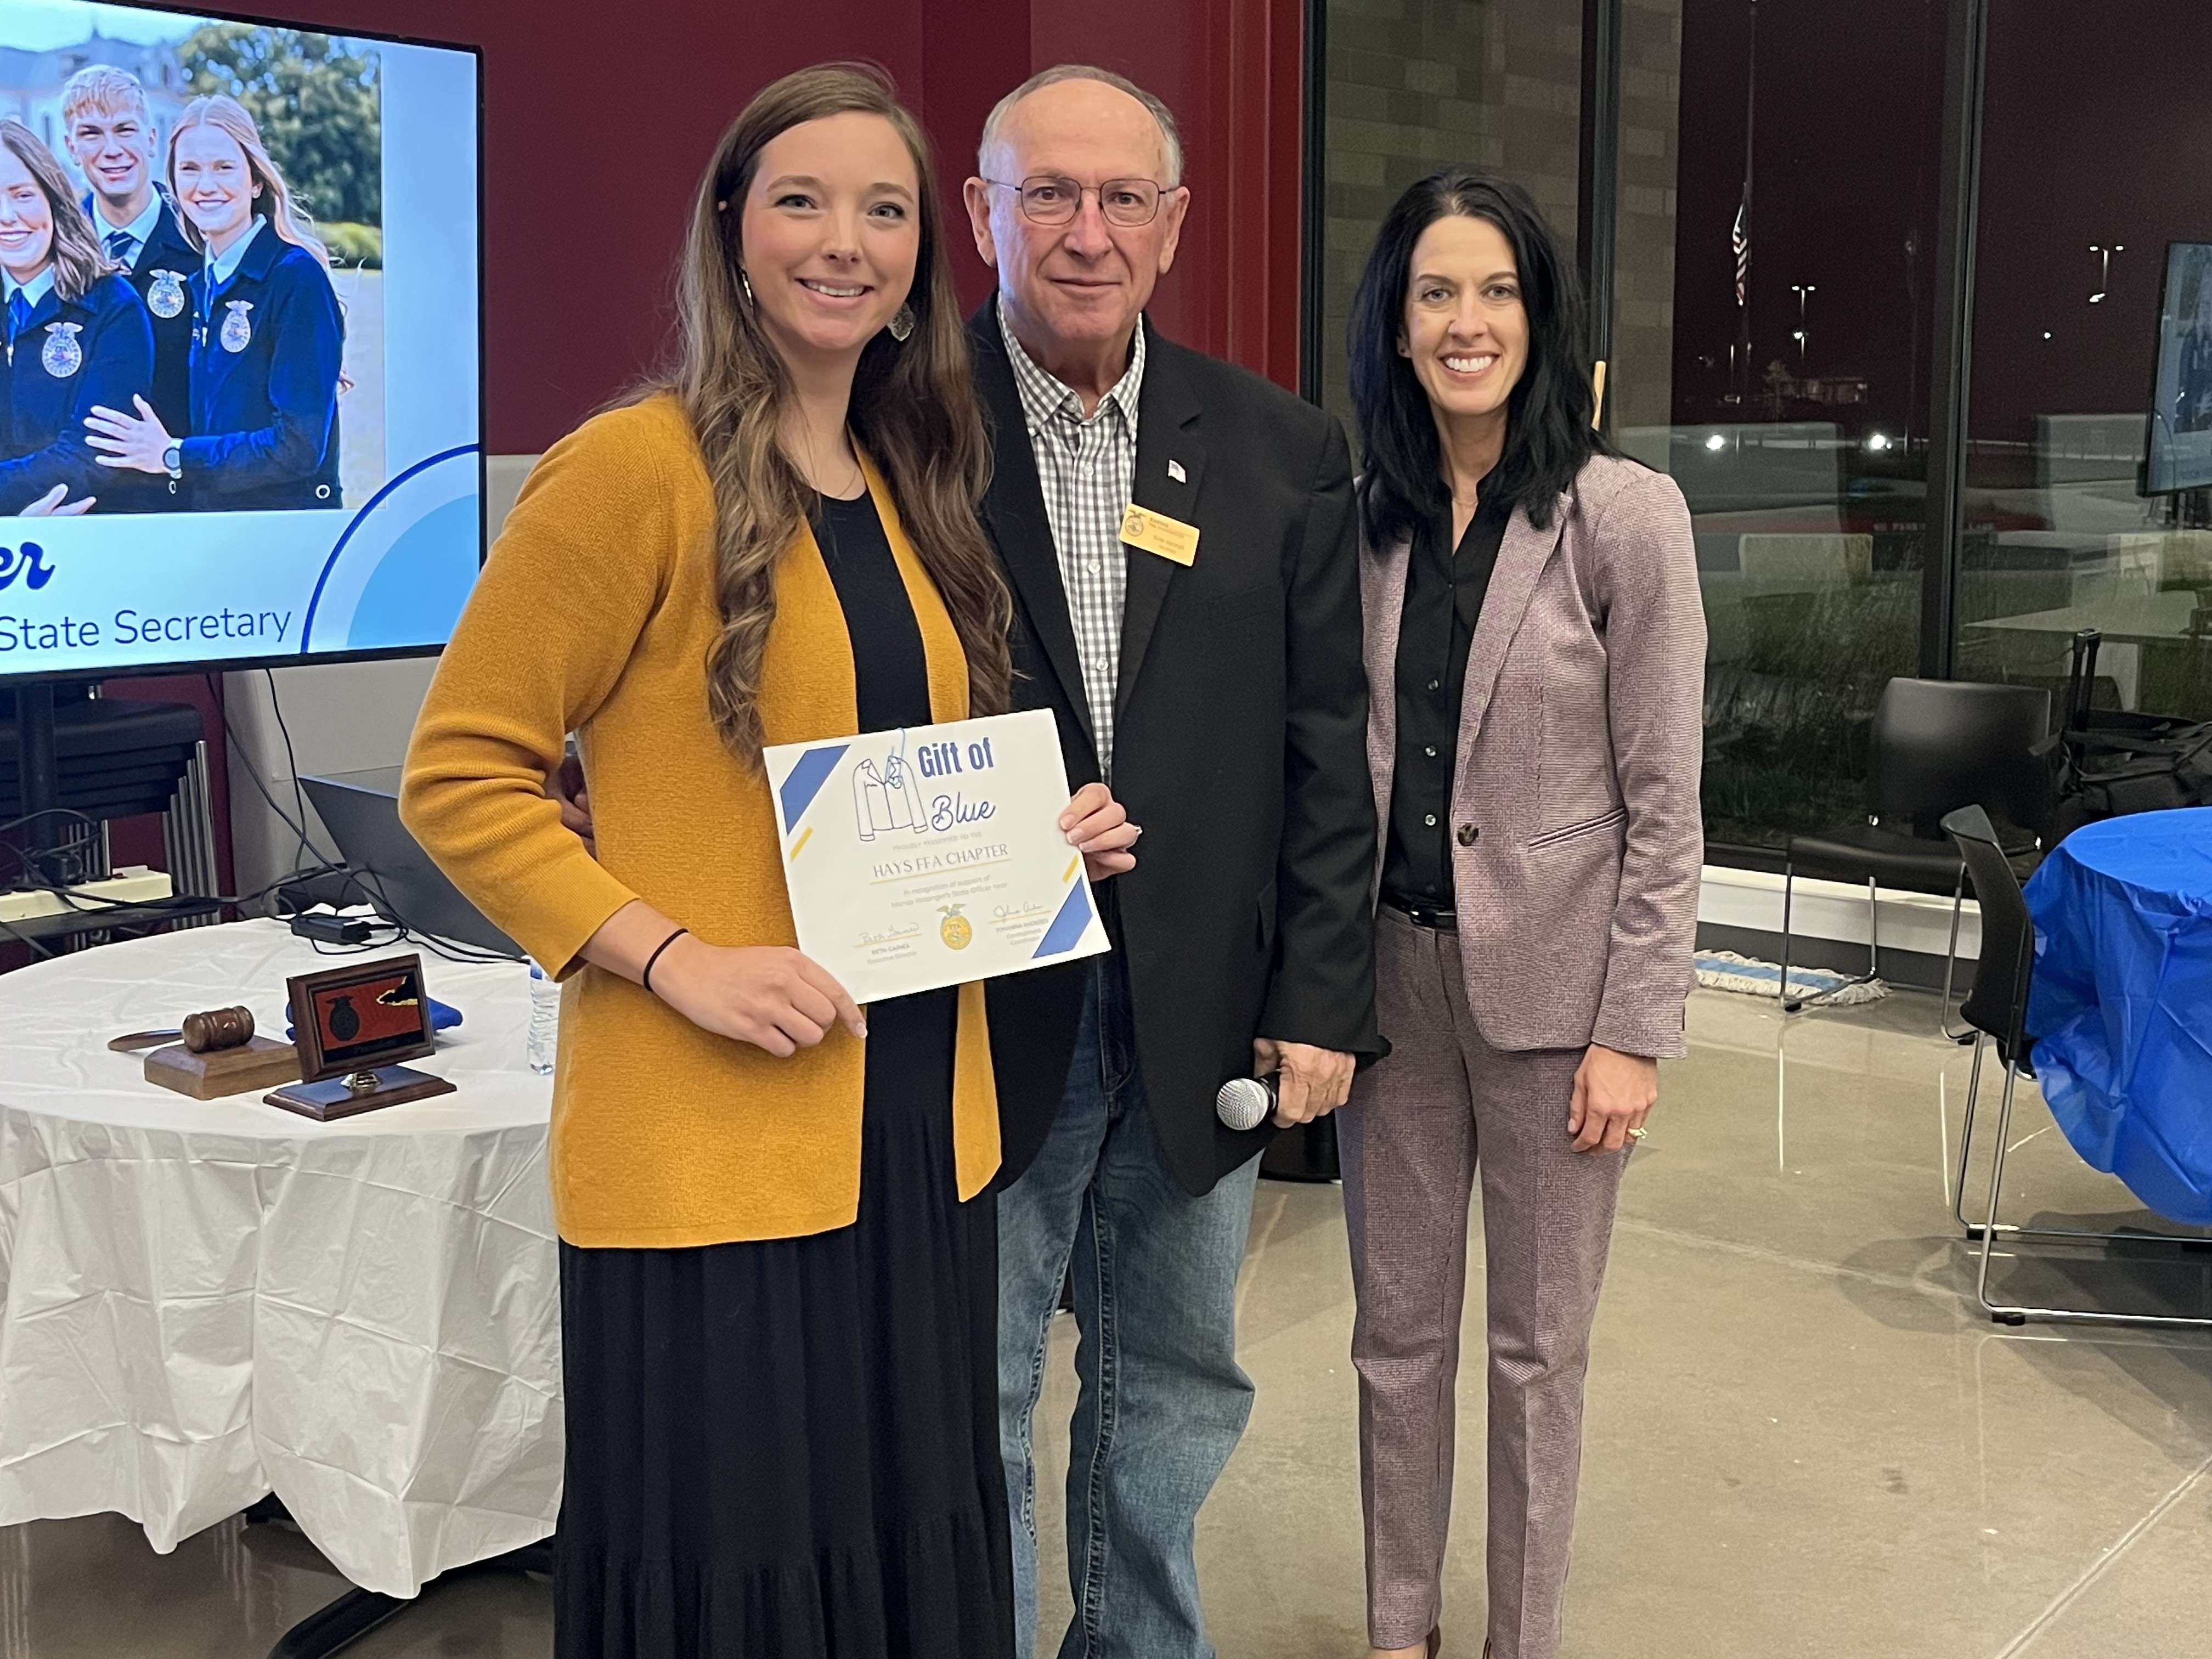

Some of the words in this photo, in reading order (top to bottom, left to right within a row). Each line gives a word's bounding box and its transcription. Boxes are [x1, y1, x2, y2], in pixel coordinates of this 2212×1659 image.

[0, 616, 99, 652] State
[114, 608, 292, 645] Secretary
[918, 742, 963, 778] Gift
[968, 737, 994, 770] of
[932, 791, 996, 832] Blue
[872, 860, 913, 878] HAYS
[916, 855, 943, 871] FFA
[945, 843, 1008, 865] CHAPTER
